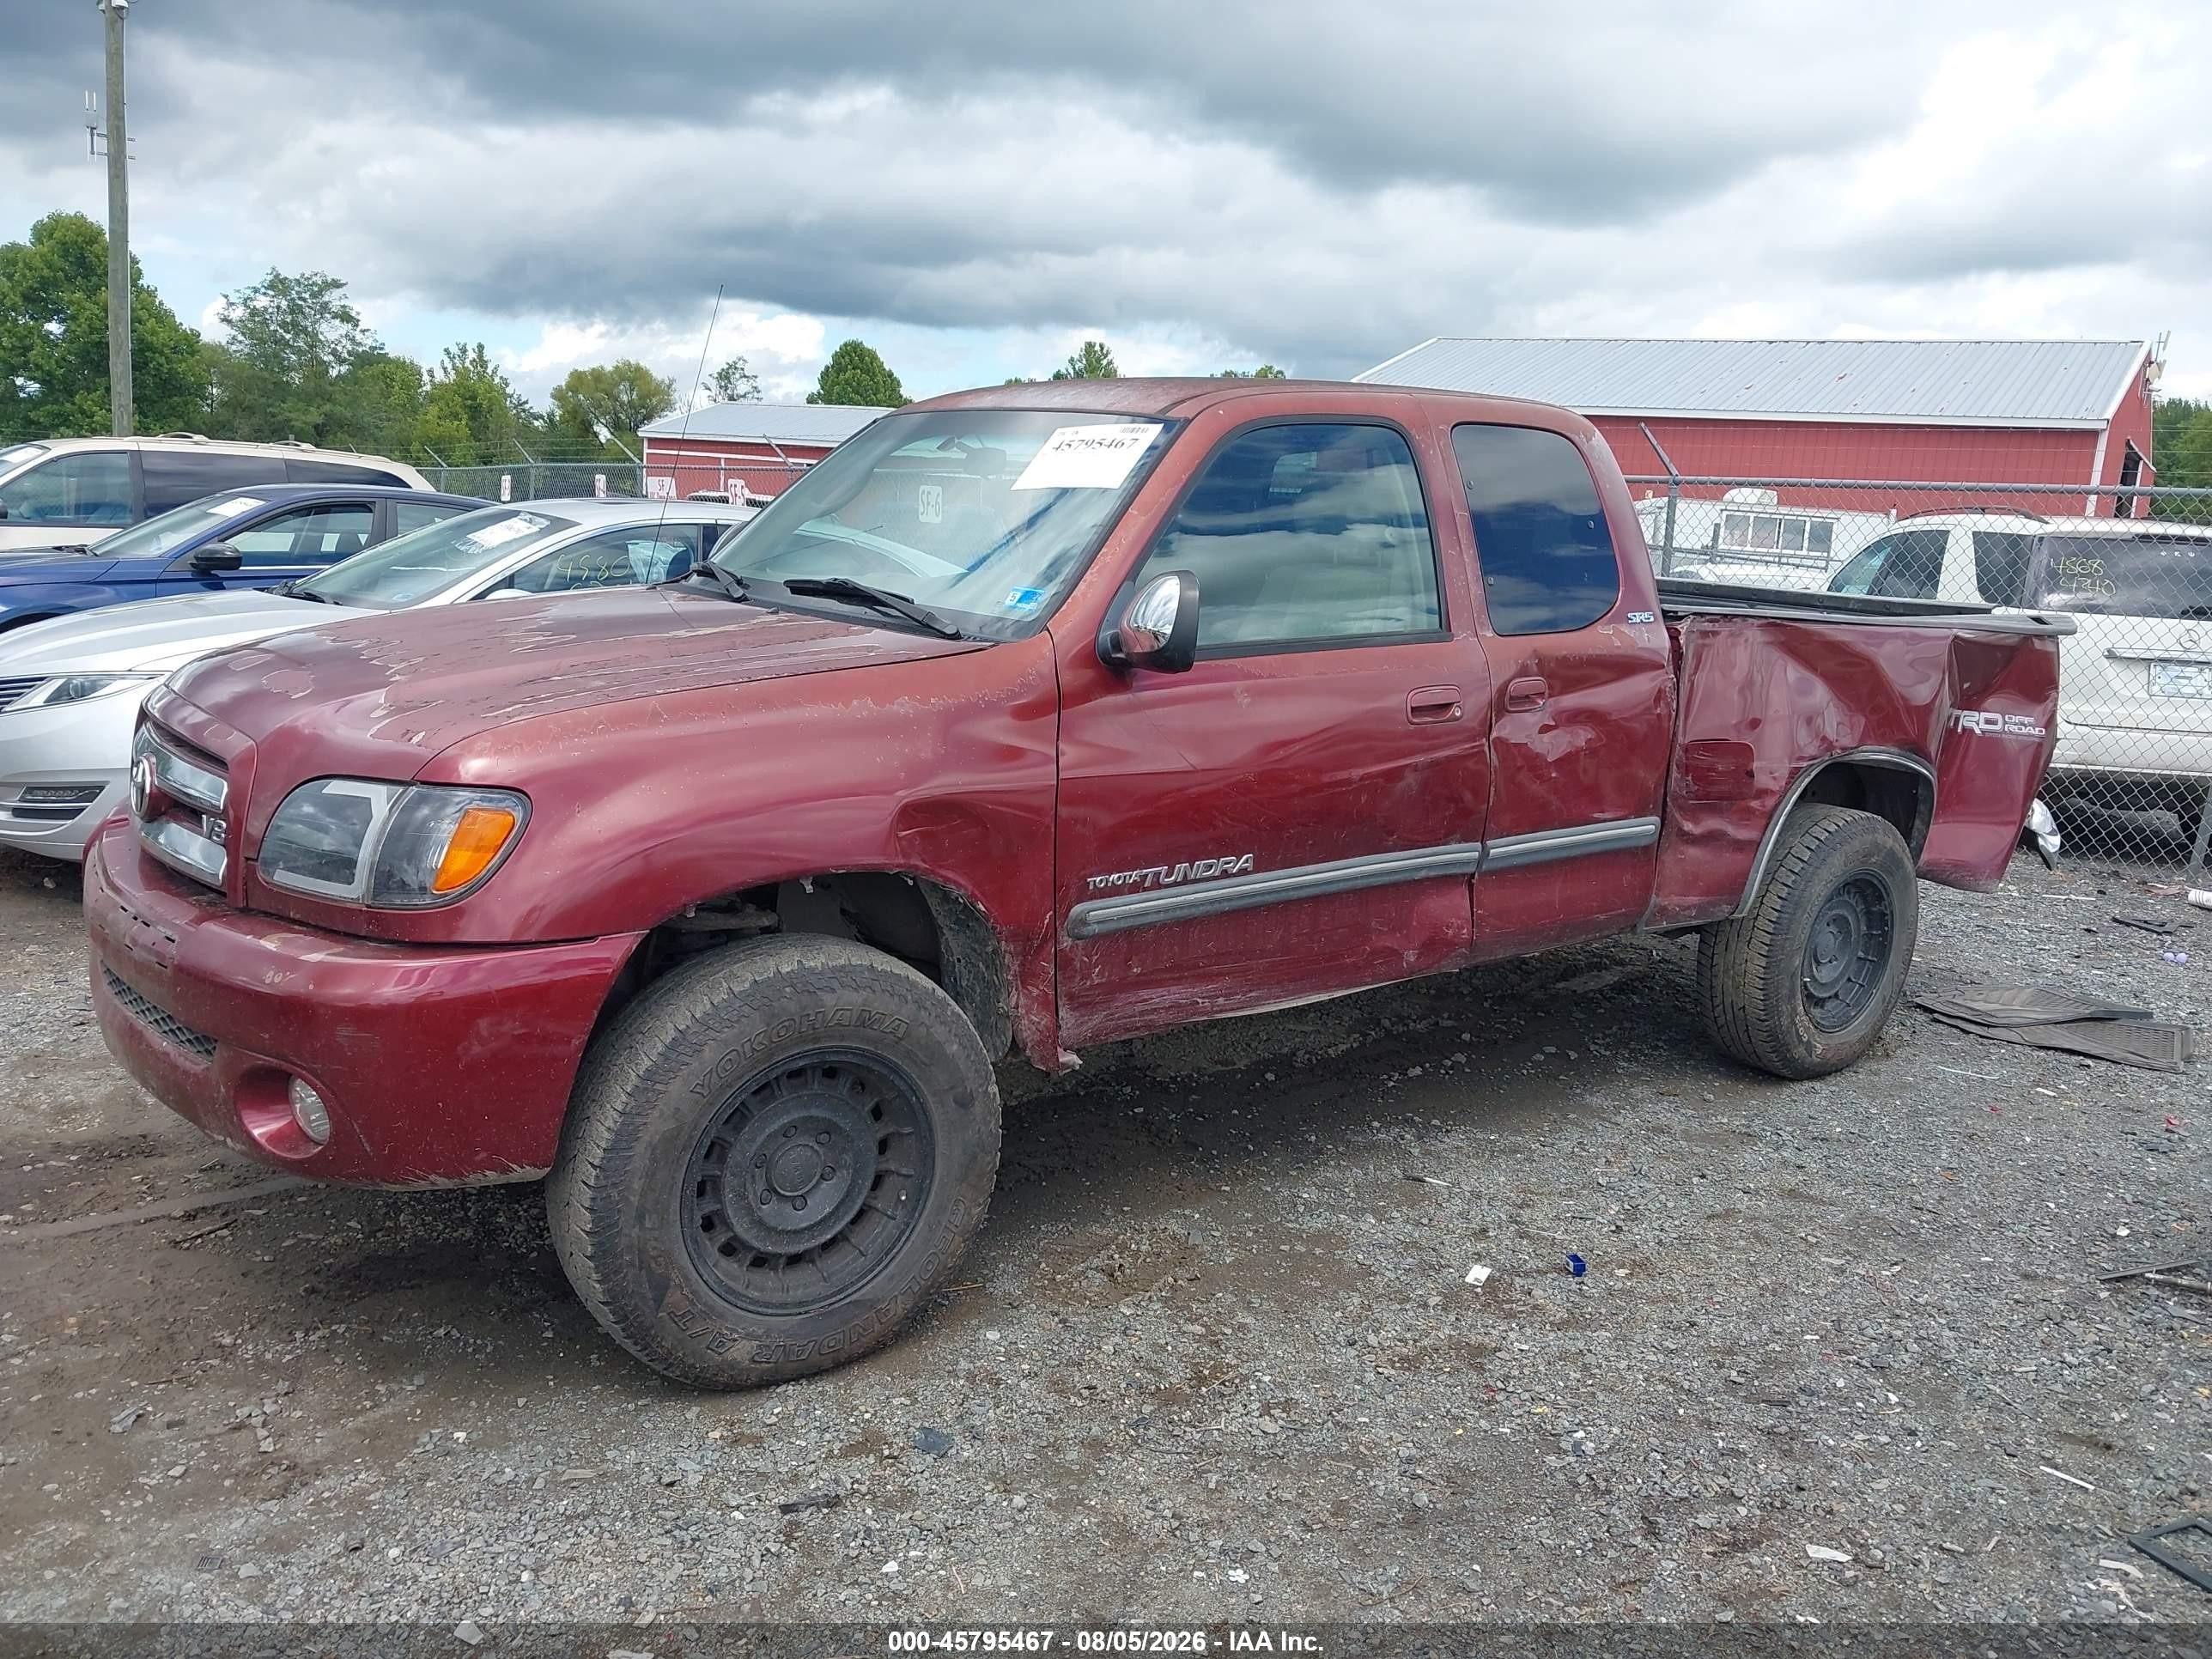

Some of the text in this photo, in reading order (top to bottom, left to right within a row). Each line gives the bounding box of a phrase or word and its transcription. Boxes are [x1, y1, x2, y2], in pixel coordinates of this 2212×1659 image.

[1052, 437, 1140, 452] 45795467
[730, 483, 746, 507] SF-5
[920, 489, 940, 517] SF-6
[1949, 708, 2004, 737] TRD
[2004, 714, 2035, 724] OFF
[2004, 724, 2047, 738] ROAD
[201, 814, 228, 842] V8
[1086, 854, 1255, 890] TOYOTA TUNDRA
[690, 1006, 910, 1099] YOKOHAMA
[665, 1196, 967, 1364] GEOLANDAR A/T
